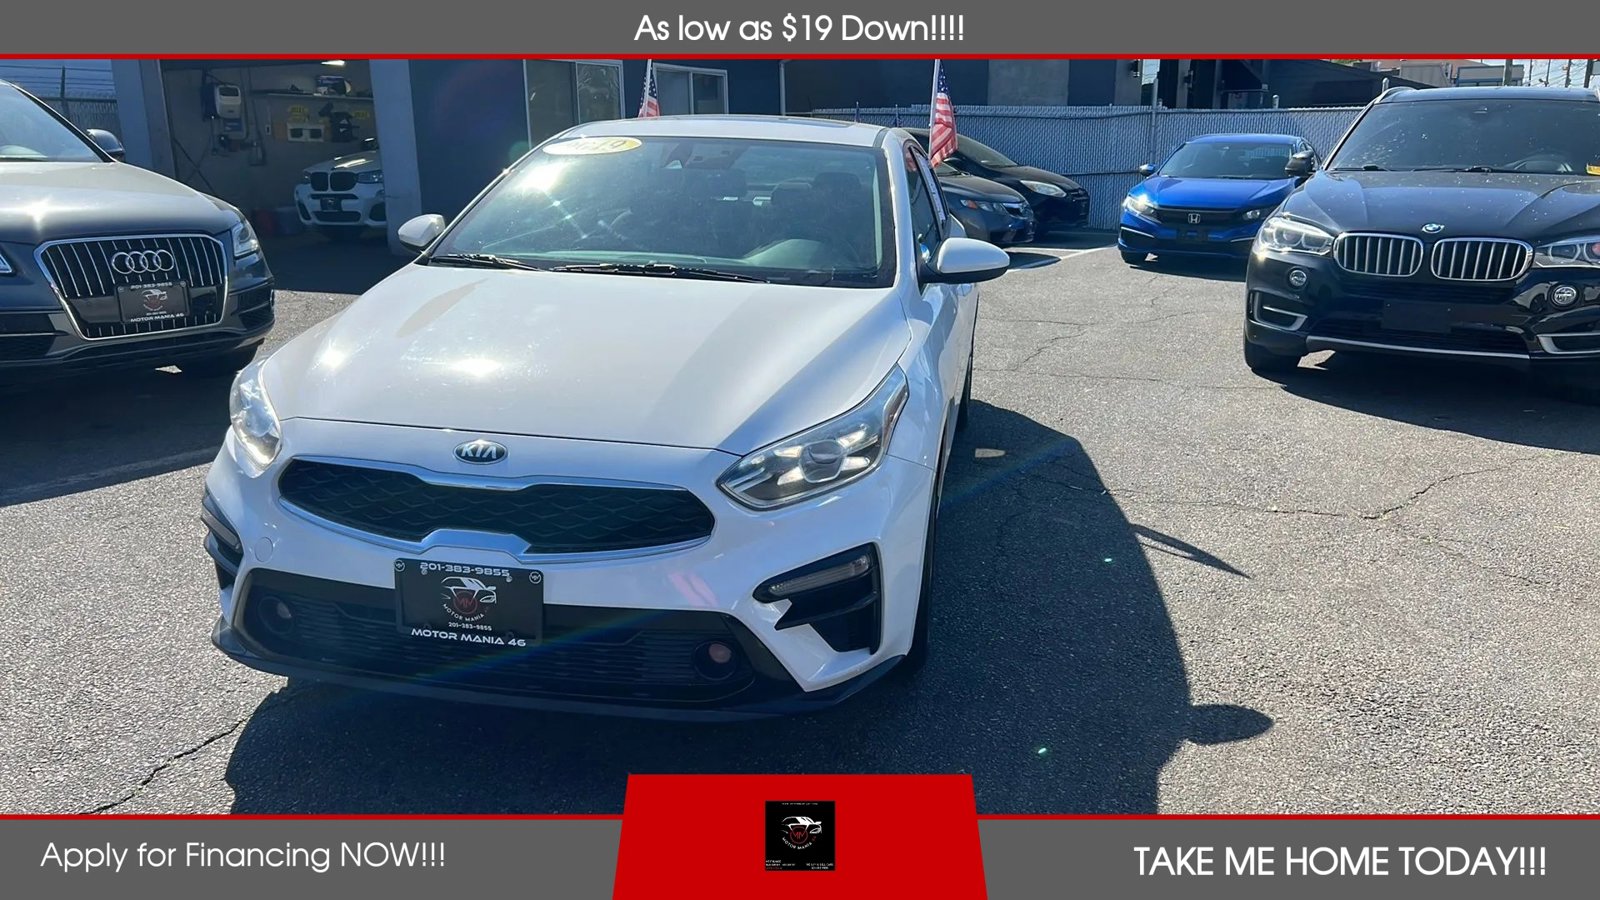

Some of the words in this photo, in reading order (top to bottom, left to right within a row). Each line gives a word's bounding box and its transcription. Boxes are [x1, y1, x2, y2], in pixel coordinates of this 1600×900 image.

[461, 444, 497, 459] KIA
[420, 562, 510, 577] 201-383-9855
[443, 603, 463, 620] MOTOR
[465, 613, 484, 621] MANIA
[448, 621, 492, 631] 201-383-9855
[411, 628, 458, 641] MOTOR
[460, 633, 504, 645] MANIA
[507, 638, 526, 647] 46
